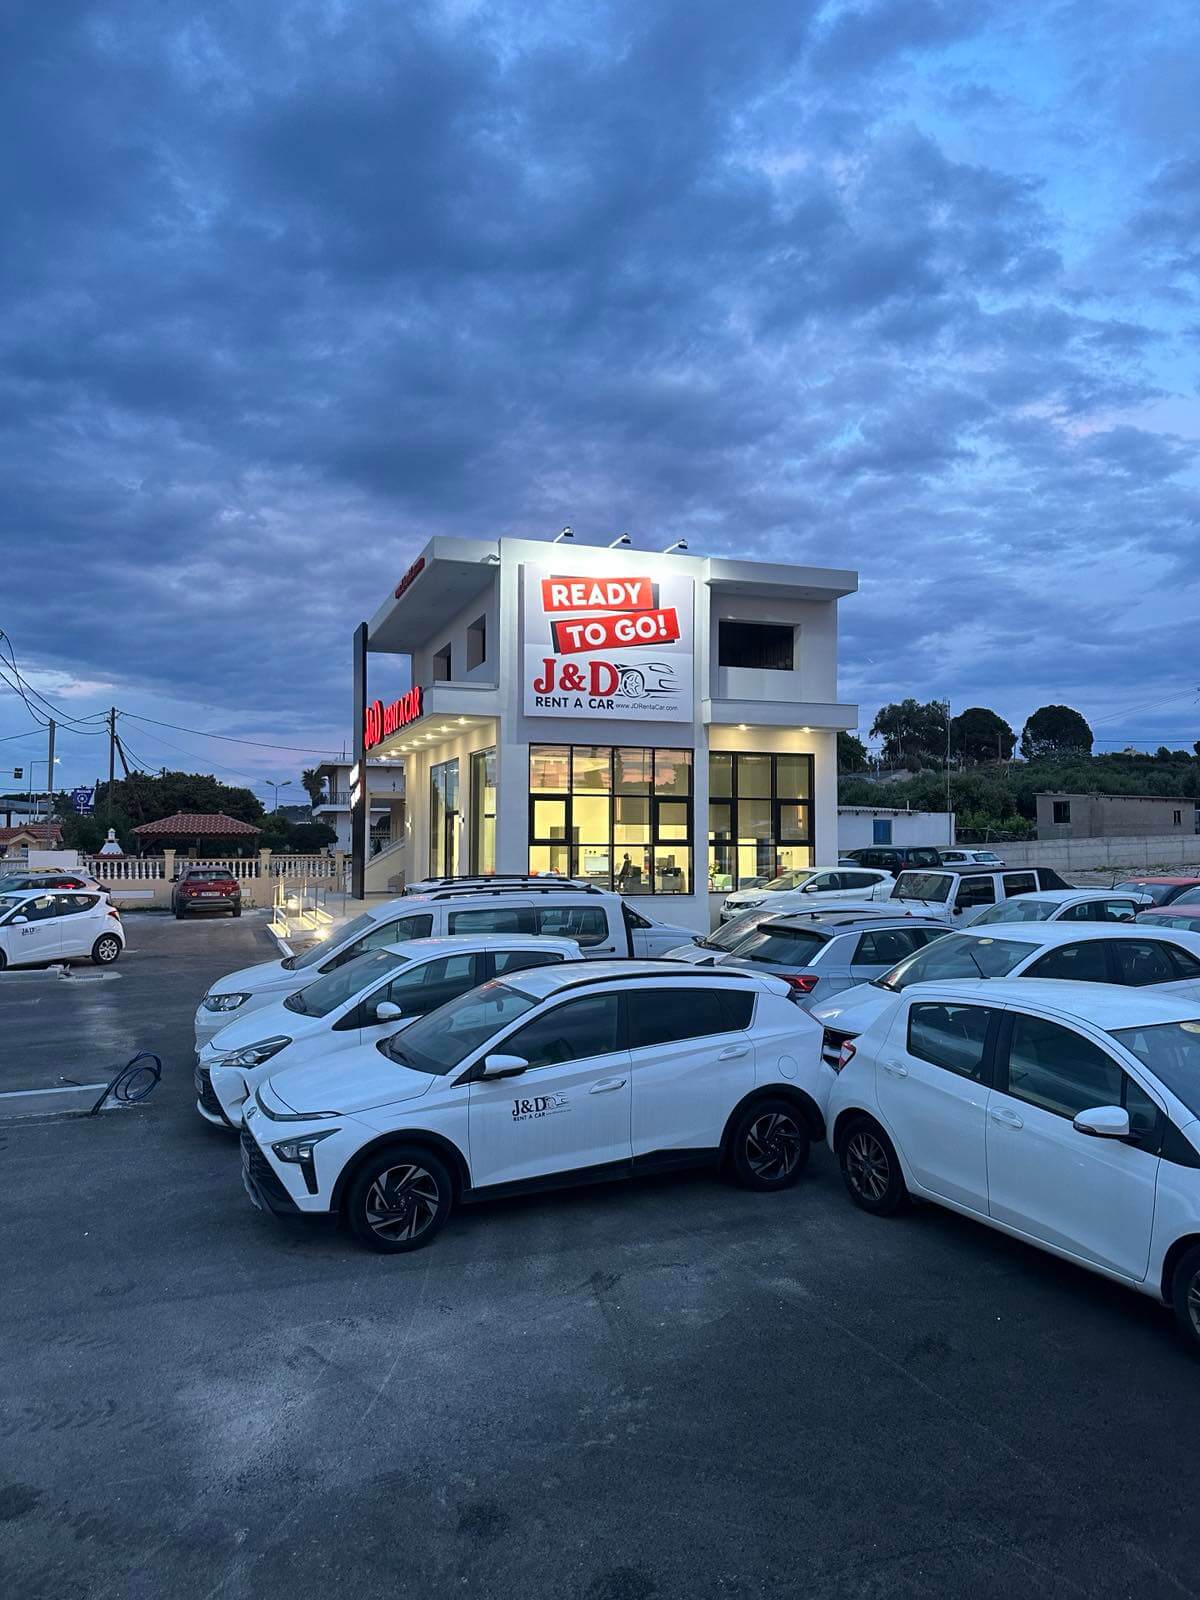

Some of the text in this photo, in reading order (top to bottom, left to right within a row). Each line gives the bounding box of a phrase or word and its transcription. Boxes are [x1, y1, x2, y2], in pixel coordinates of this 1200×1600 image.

[551, 582, 642, 607] READY
[566, 614, 668, 648] TO GO!
[533, 658, 619, 697] J&D
[535, 696, 570, 708] RENT
[573, 697, 583, 709] A
[588, 698, 614, 710] CAR
[364, 687, 420, 750] J&D RENT A CAR
[512, 1096, 547, 1117] J&D
